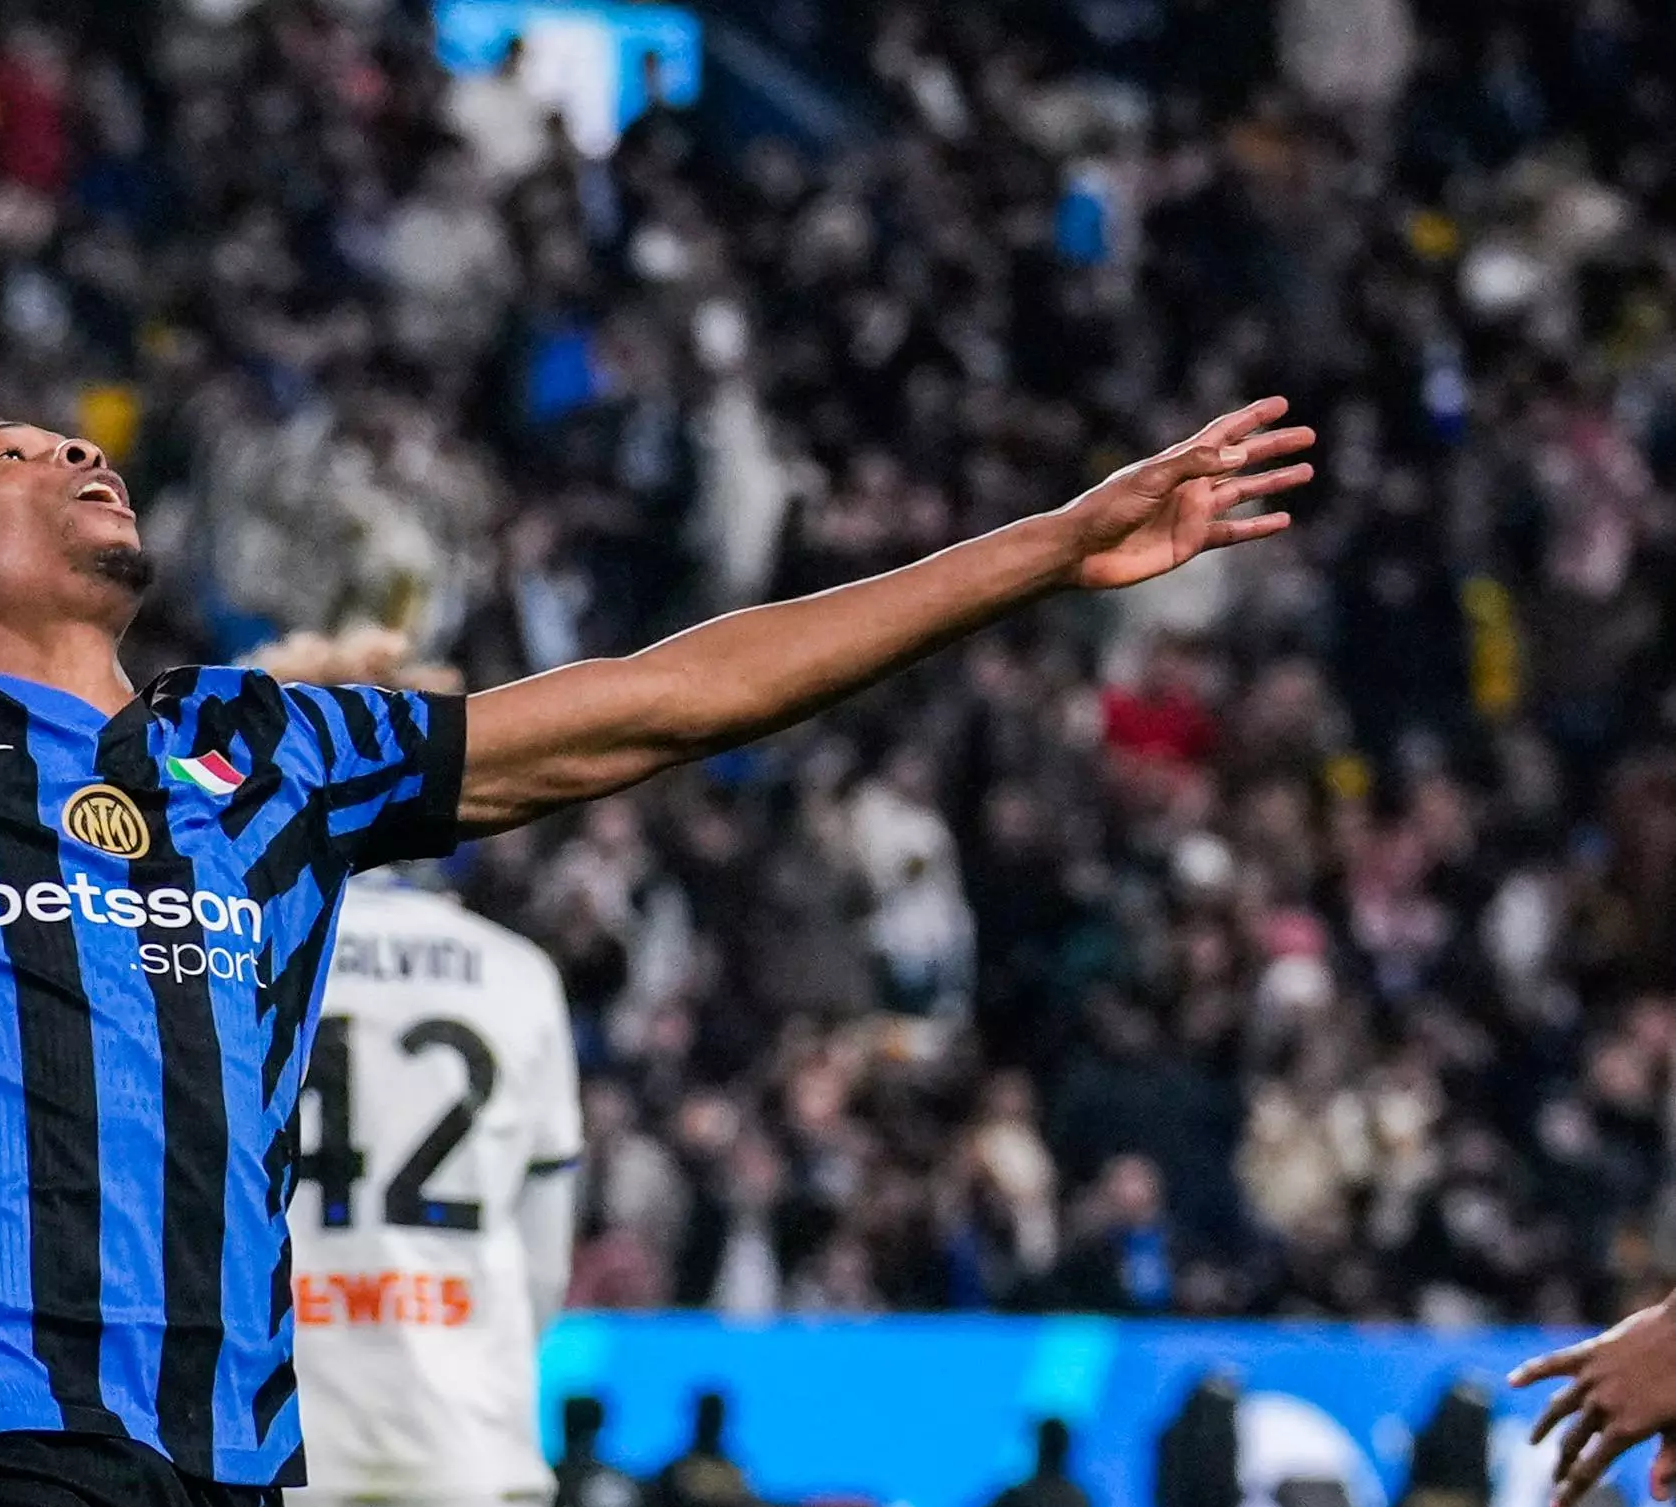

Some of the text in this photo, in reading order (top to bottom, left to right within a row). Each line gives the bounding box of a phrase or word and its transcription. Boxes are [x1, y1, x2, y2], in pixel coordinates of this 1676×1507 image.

[130, 943, 267, 989] .sport
[298, 1014, 498, 1231] 42
[294, 1271, 473, 1327] EWISS
